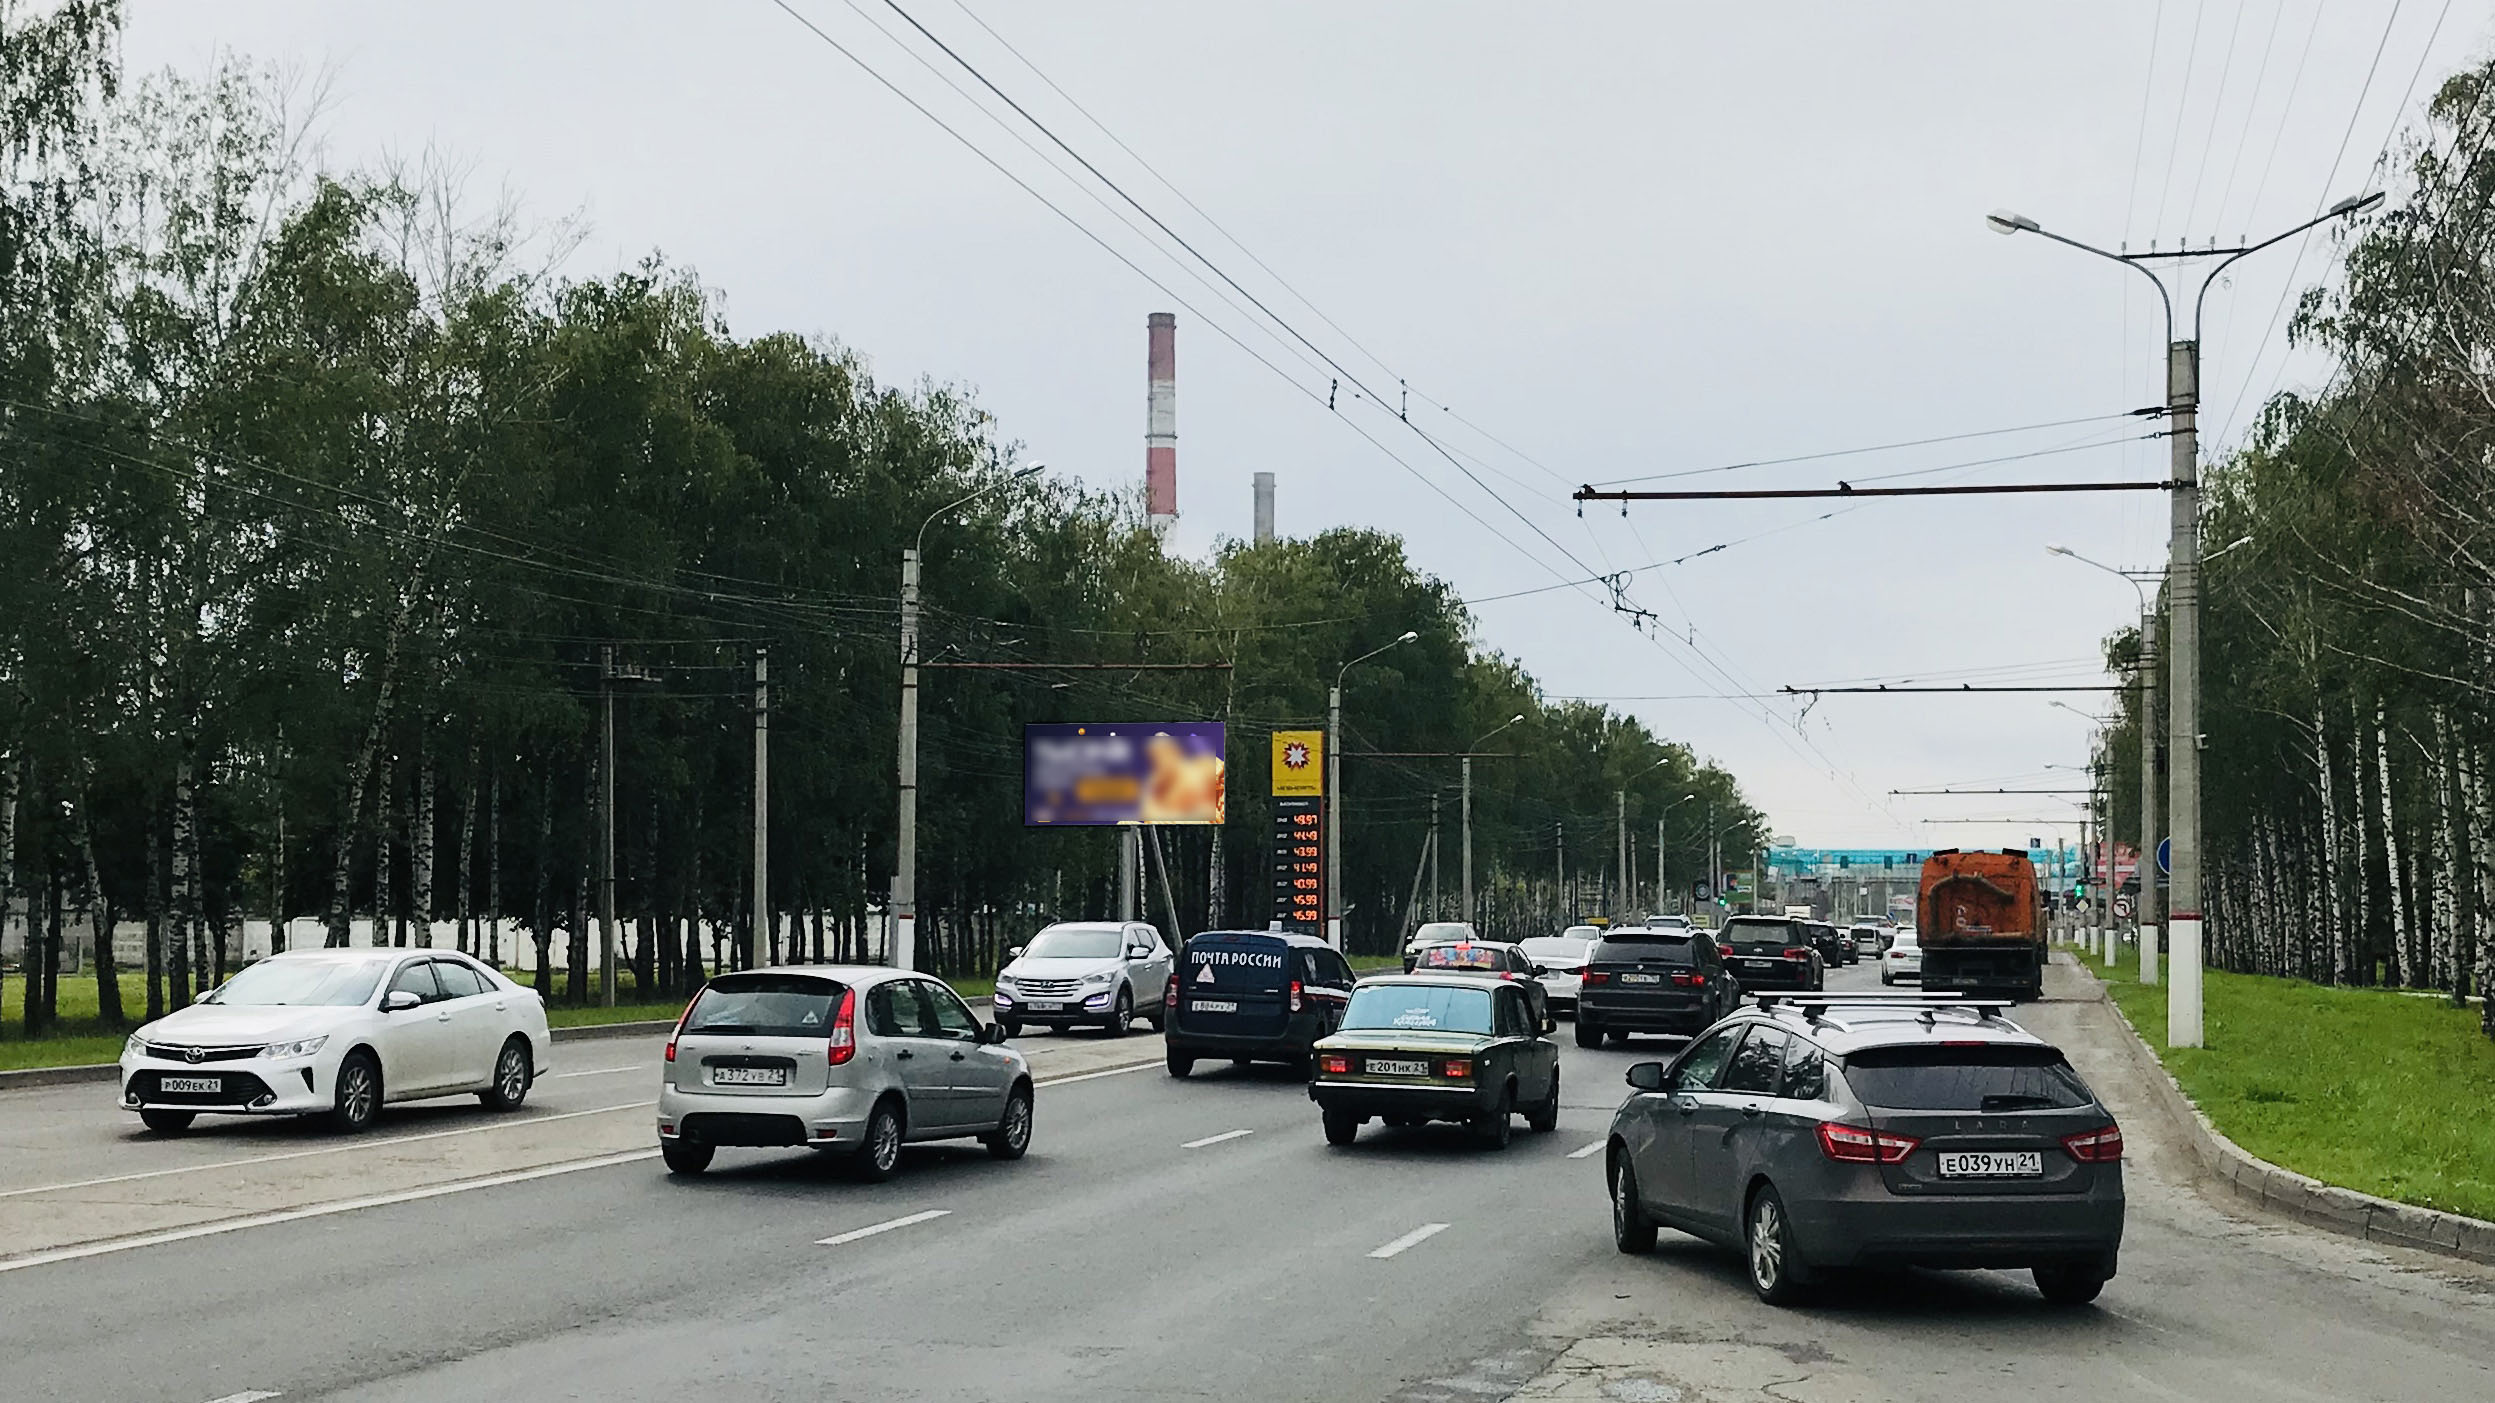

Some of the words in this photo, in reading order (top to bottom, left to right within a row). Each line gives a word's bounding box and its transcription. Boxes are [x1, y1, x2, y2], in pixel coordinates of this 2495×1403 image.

[1191, 951, 1229, 965] ПОЧТА
[1231, 952, 1282, 969] РОССИИ
[1955, 1119, 2031, 1131] LADA
